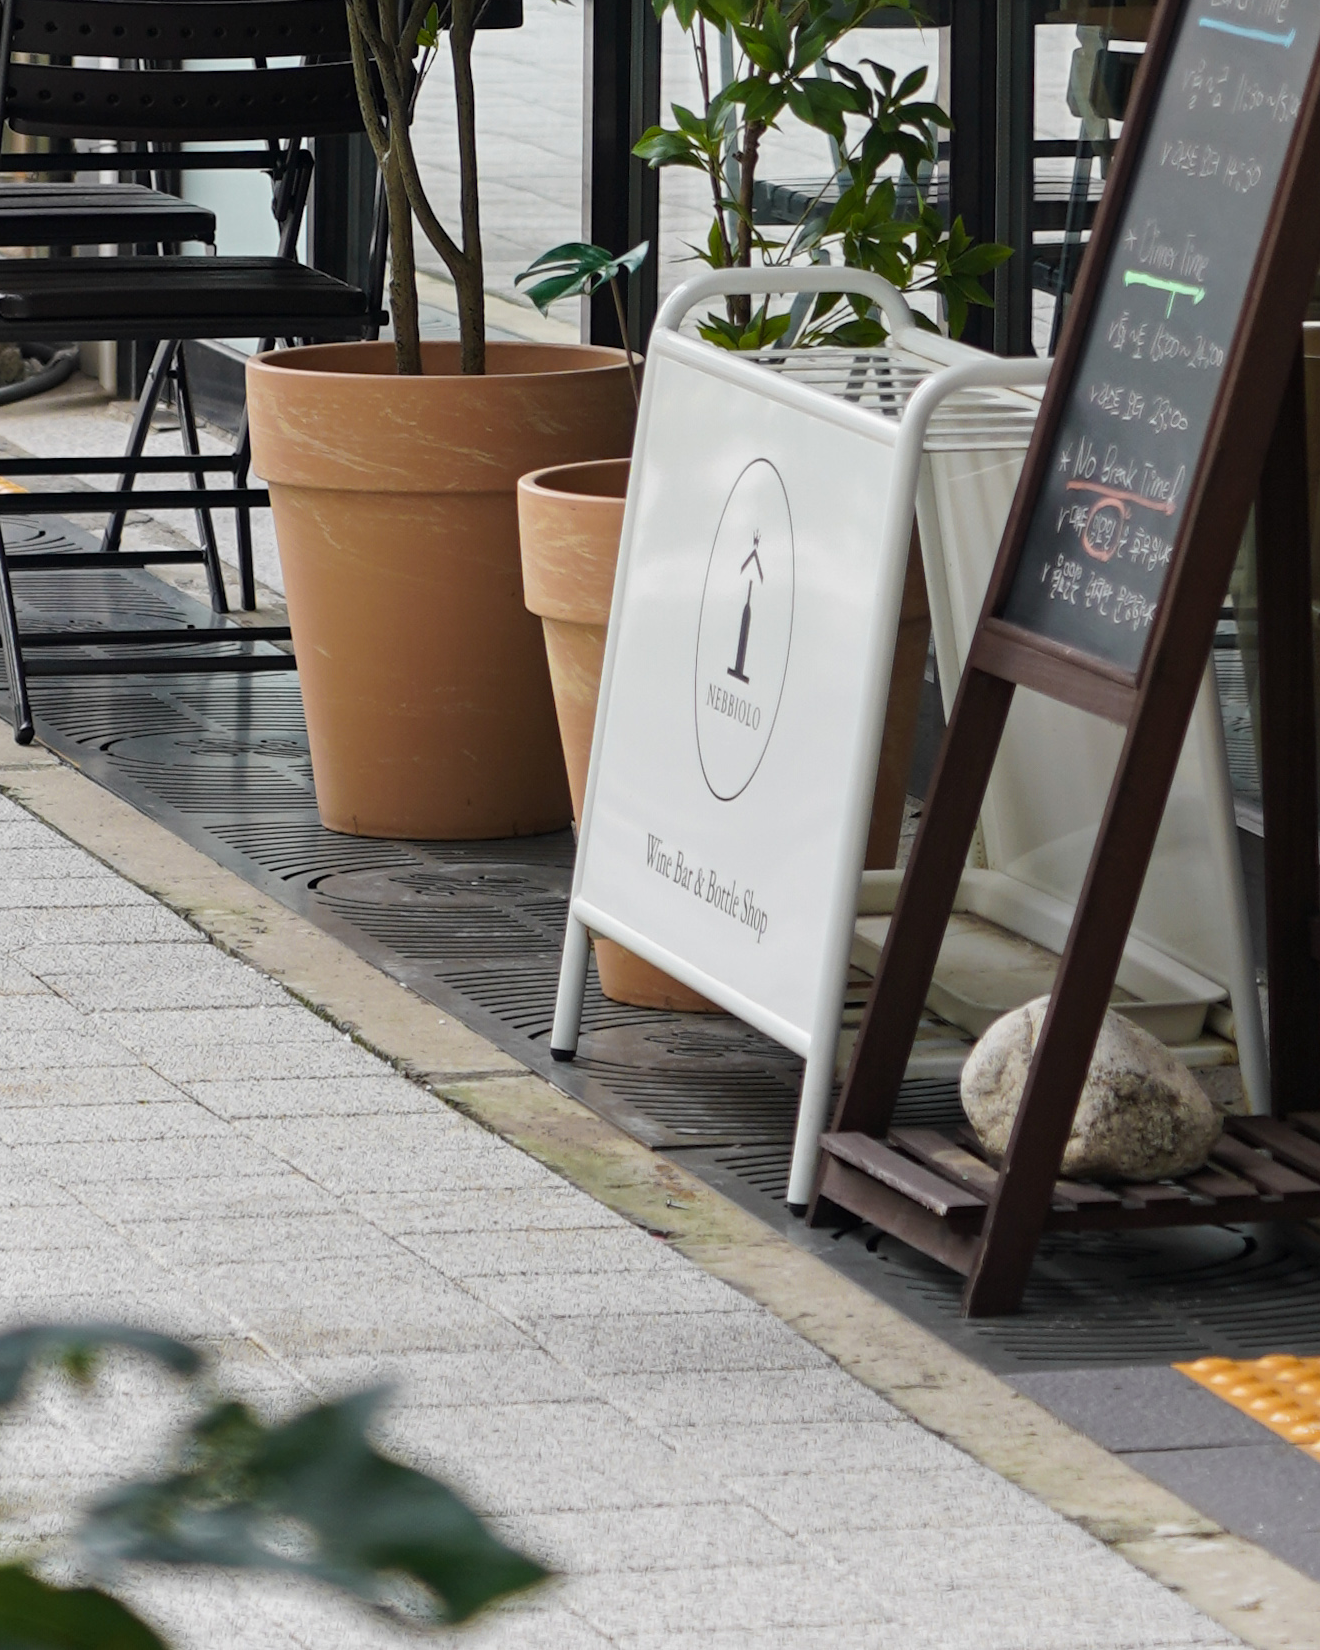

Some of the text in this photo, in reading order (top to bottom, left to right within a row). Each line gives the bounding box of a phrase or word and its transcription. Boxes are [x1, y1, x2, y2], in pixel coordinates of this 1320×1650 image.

[1179, 233, 1210, 282] Time
[1149, 396, 1189, 434] 23:00
[1073, 435, 1097, 479] No
[1100, 443, 1138, 490] Break
[706, 682, 761, 731] NEBBIOLO
[646, 832, 768, 944] Wine Bar & Bottle Shop
